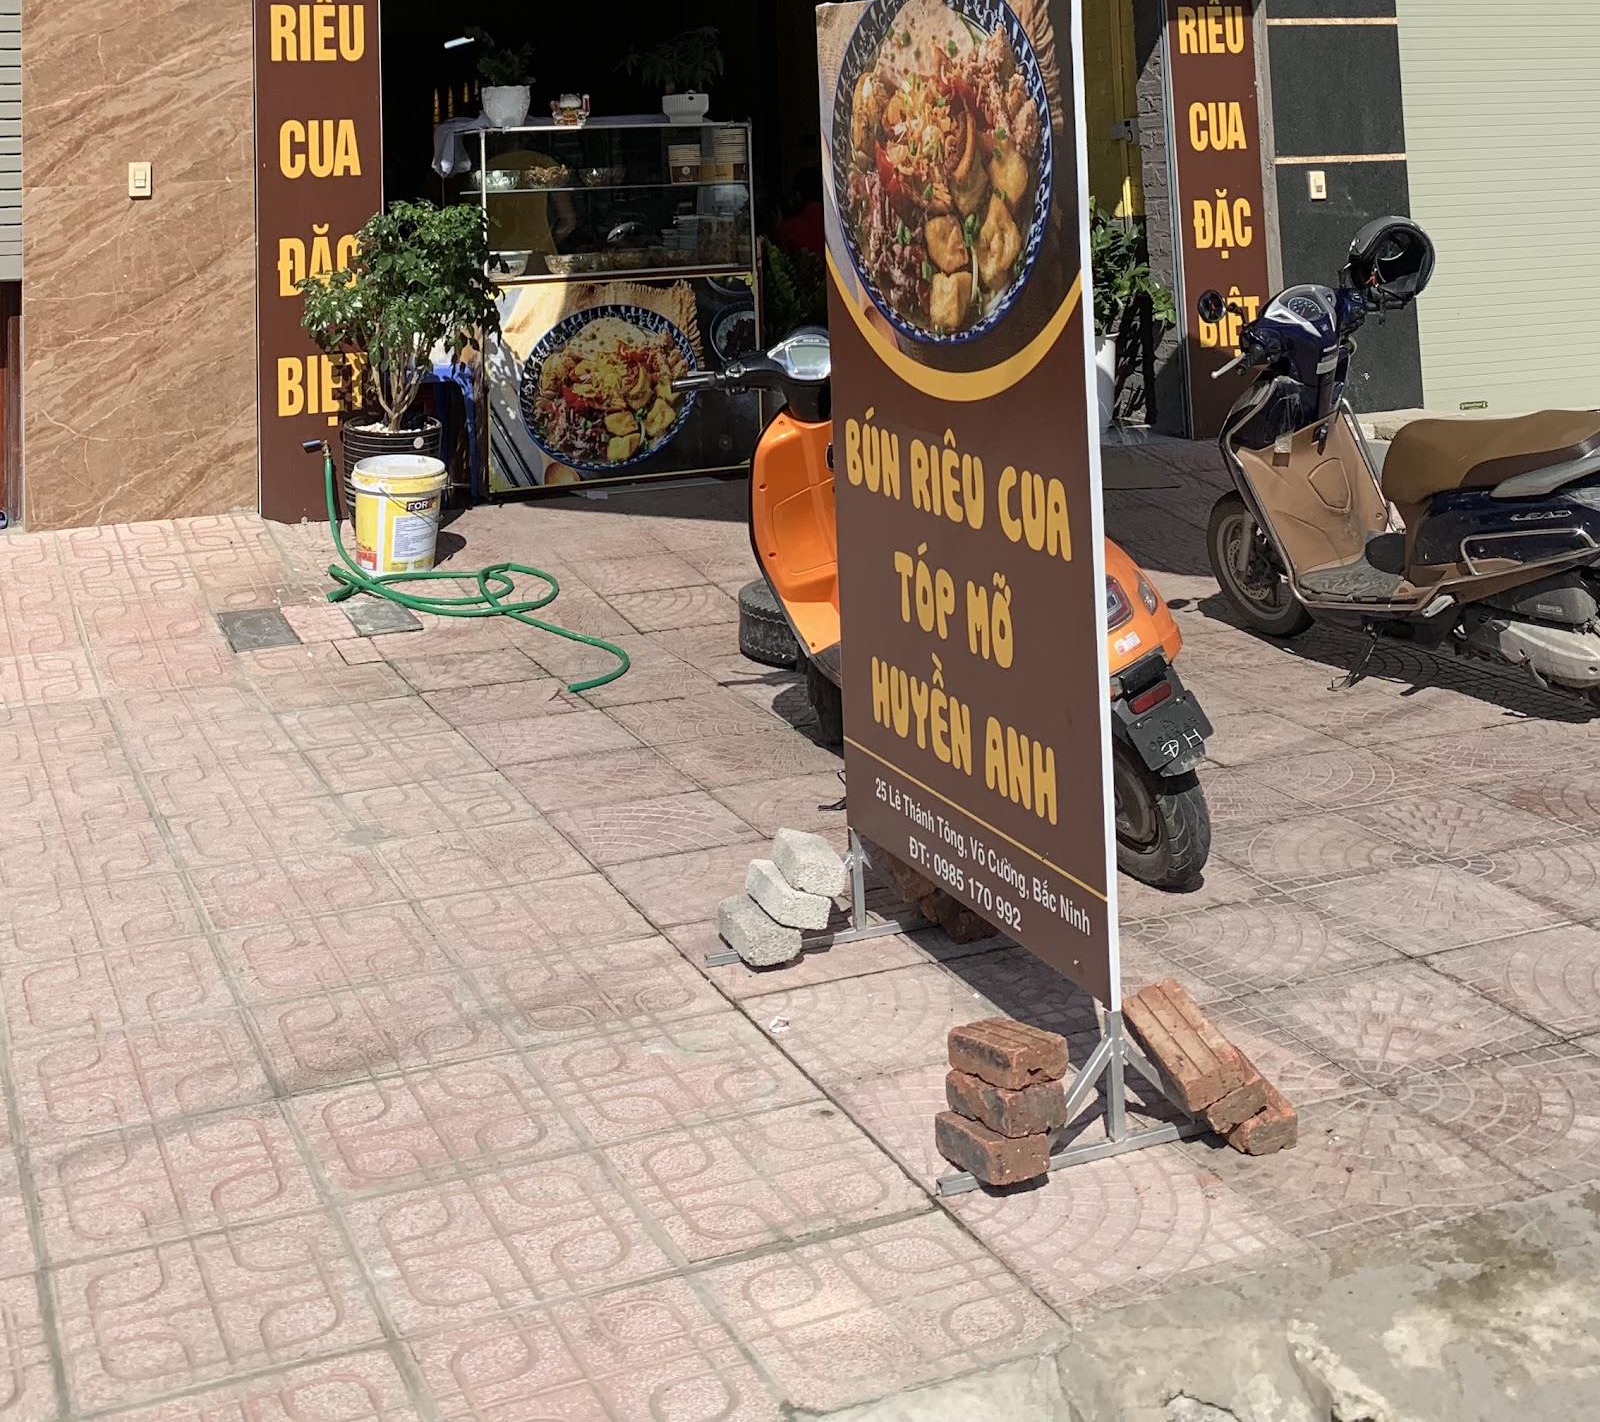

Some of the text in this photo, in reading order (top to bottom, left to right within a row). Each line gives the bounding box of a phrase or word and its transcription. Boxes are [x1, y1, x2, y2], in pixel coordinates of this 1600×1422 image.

[278, 119, 362, 179] CUA
[1188, 101, 1248, 152] CUA
[1193, 188, 1253, 259] ĐẶC
[845, 406, 1072, 562] BÚN RIÊU CUA
[894, 541, 1014, 669] TÓP MỠ
[871, 652, 1057, 826] HUYỀN ANH
[875, 777, 1091, 937] 25 Lê Thánh Tông, Võ Cường, Bắc Ninh
[908, 835, 1022, 933] ĐT: 0985 170 992
